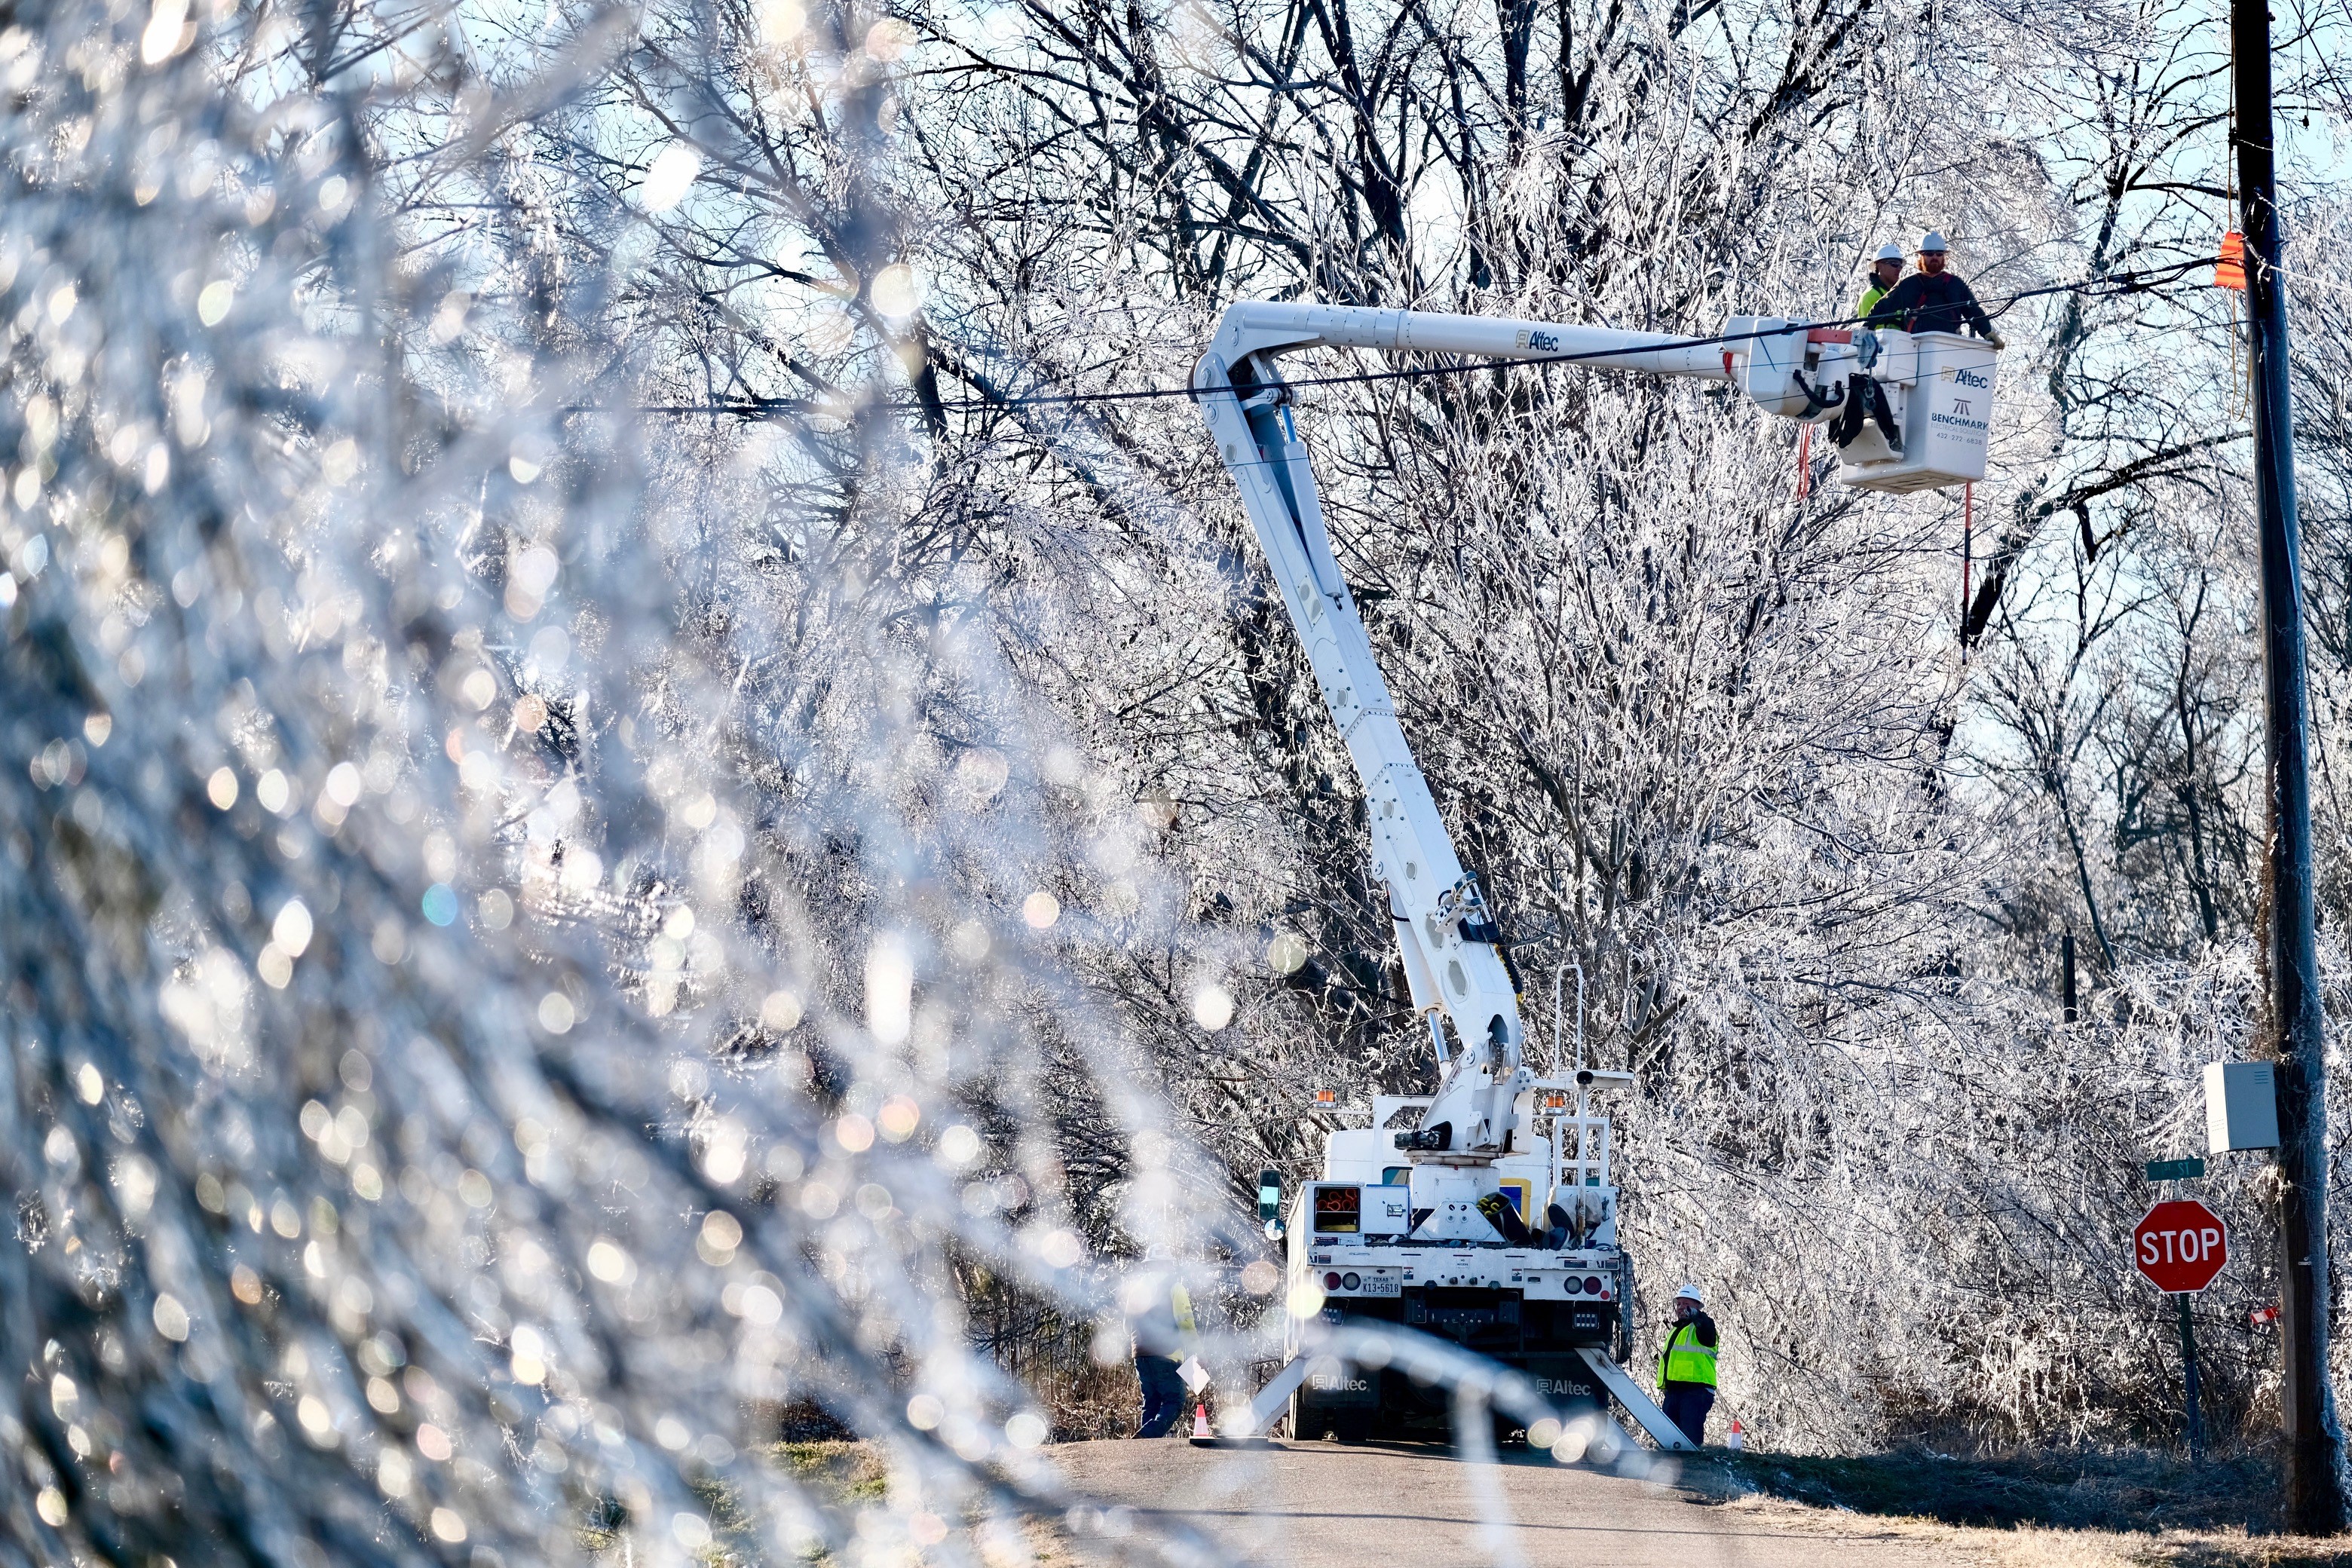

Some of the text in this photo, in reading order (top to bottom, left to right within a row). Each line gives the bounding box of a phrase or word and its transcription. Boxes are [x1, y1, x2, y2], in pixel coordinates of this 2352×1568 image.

[1530, 331, 1558, 352] Altec
[1955, 369, 1988, 388] Altec
[1931, 412, 1989, 430] BENCHMARK
[1931, 422, 1958, 433] ELECTRICAL
[2178, 1162, 2189, 1175] ST
[2142, 1228, 2219, 1265] STOP
[1328, 1375, 1367, 1392] Altec
[1553, 1380, 1591, 1396] Altec
